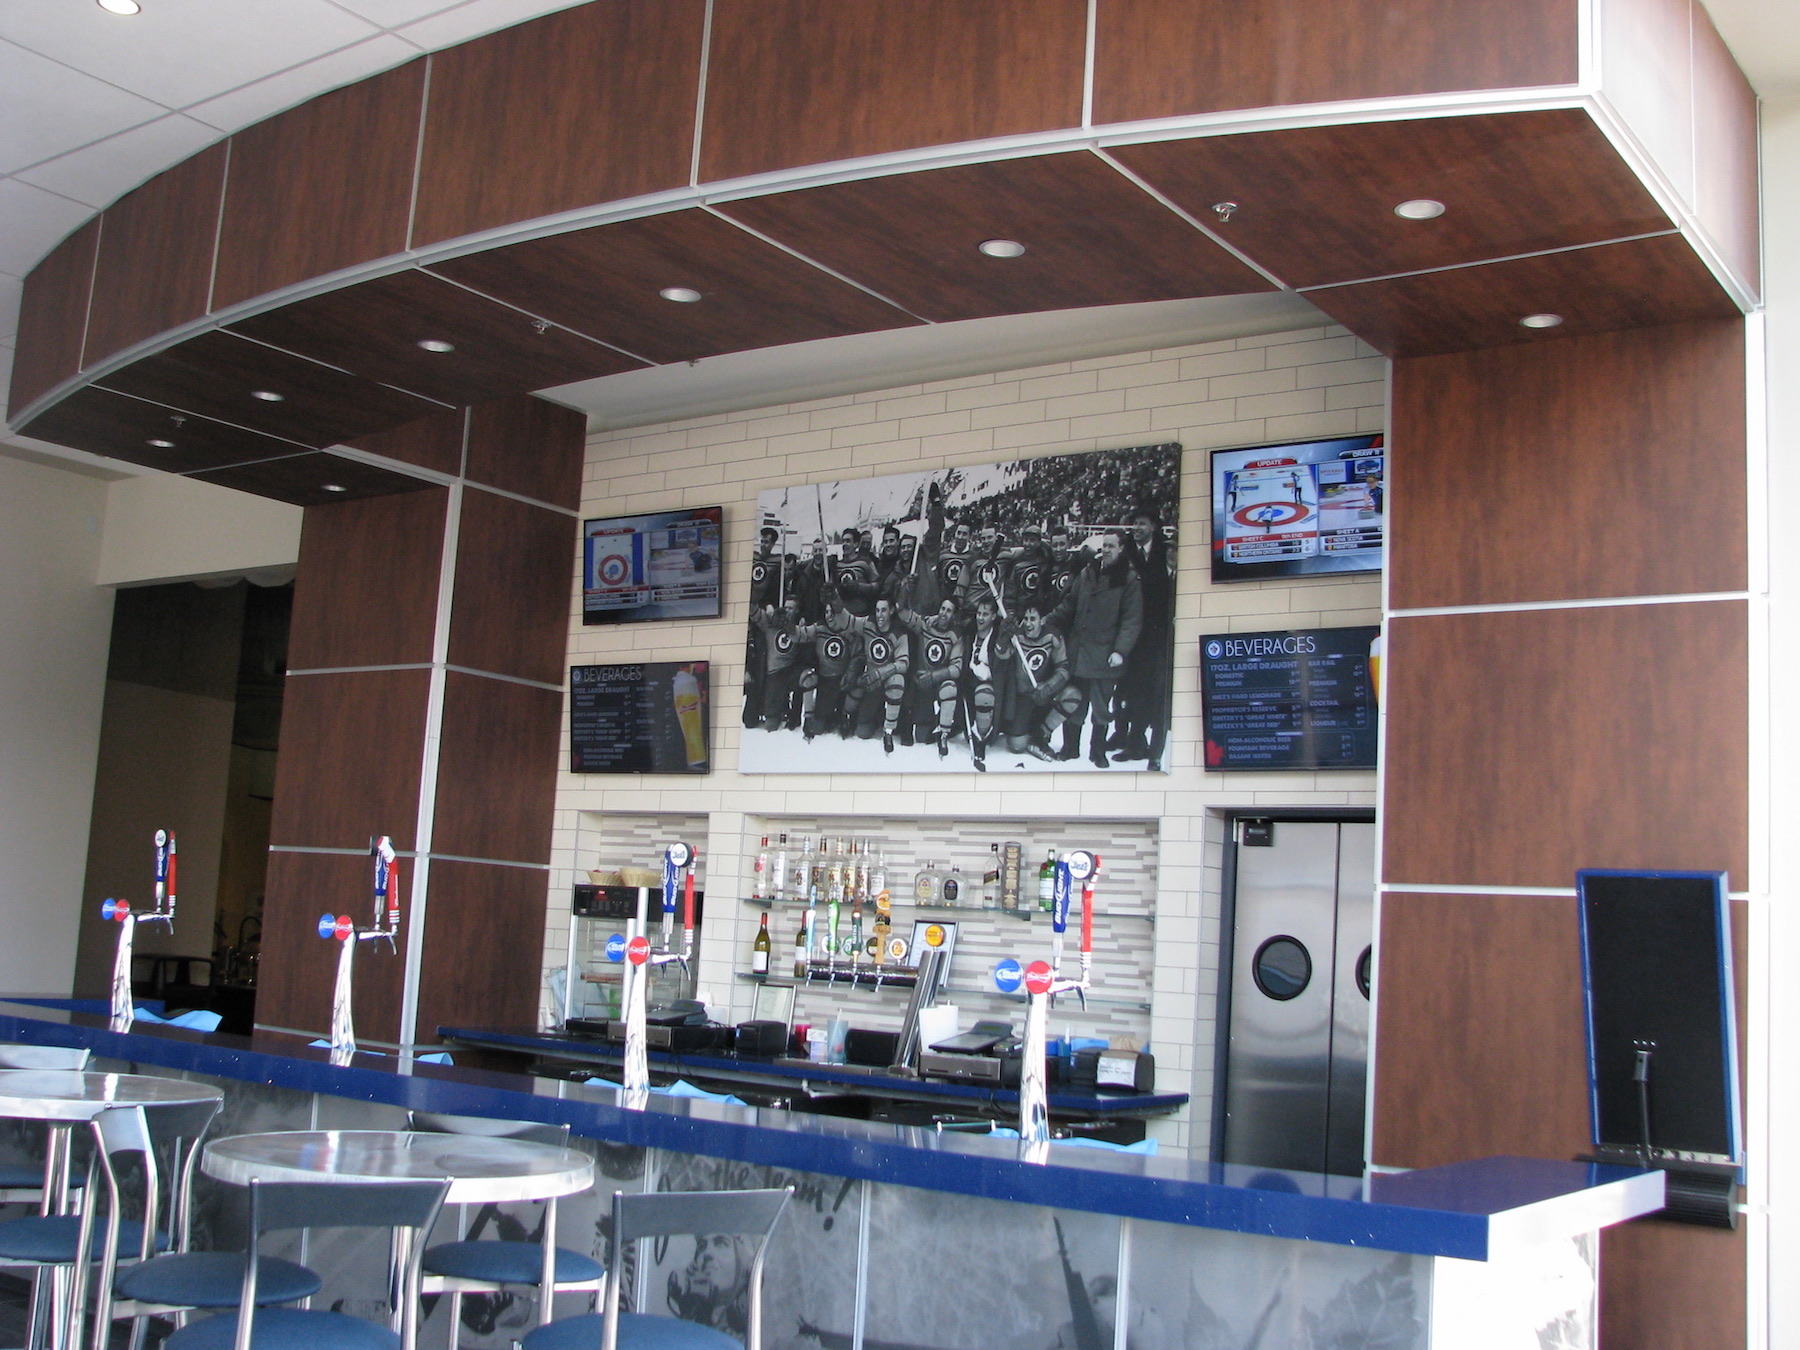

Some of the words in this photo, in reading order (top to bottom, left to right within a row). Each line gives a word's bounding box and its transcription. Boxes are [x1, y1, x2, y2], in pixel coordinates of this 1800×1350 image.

[1225, 636, 1316, 657] BEVERAGES
[583, 666, 642, 682] BEVERAGES
[1232, 662, 1258, 671] LARGE
[1259, 661, 1298, 670] DRAUGHT
[1056, 868, 1065, 898] LIGHT
[1054, 901, 1062, 925] BUD
